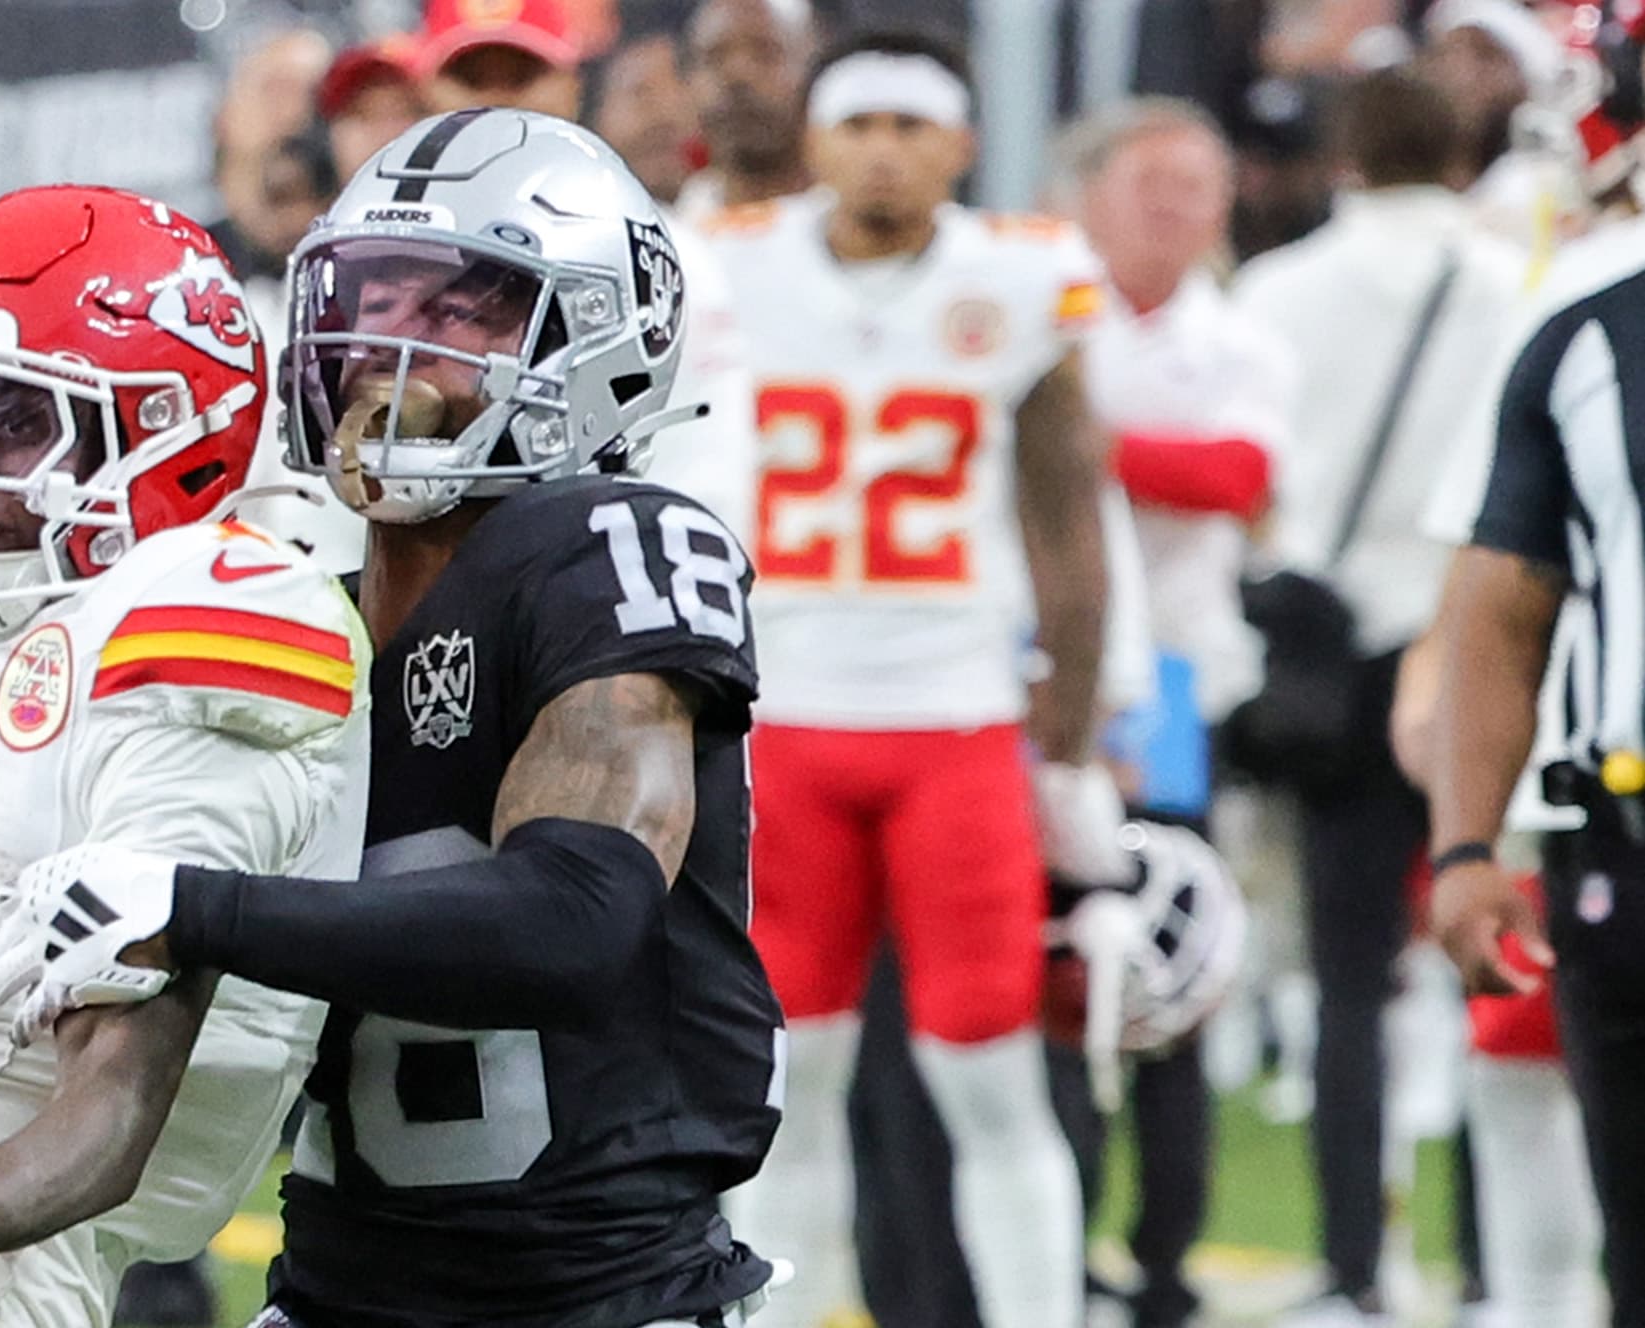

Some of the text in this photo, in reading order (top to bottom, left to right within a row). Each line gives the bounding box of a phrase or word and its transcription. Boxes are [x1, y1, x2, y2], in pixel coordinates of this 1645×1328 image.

[364, 209, 433, 224] RAIDERS
[754, 380, 982, 583] 22
[588, 500, 747, 648] 18
[411, 662, 469, 706] LXV
